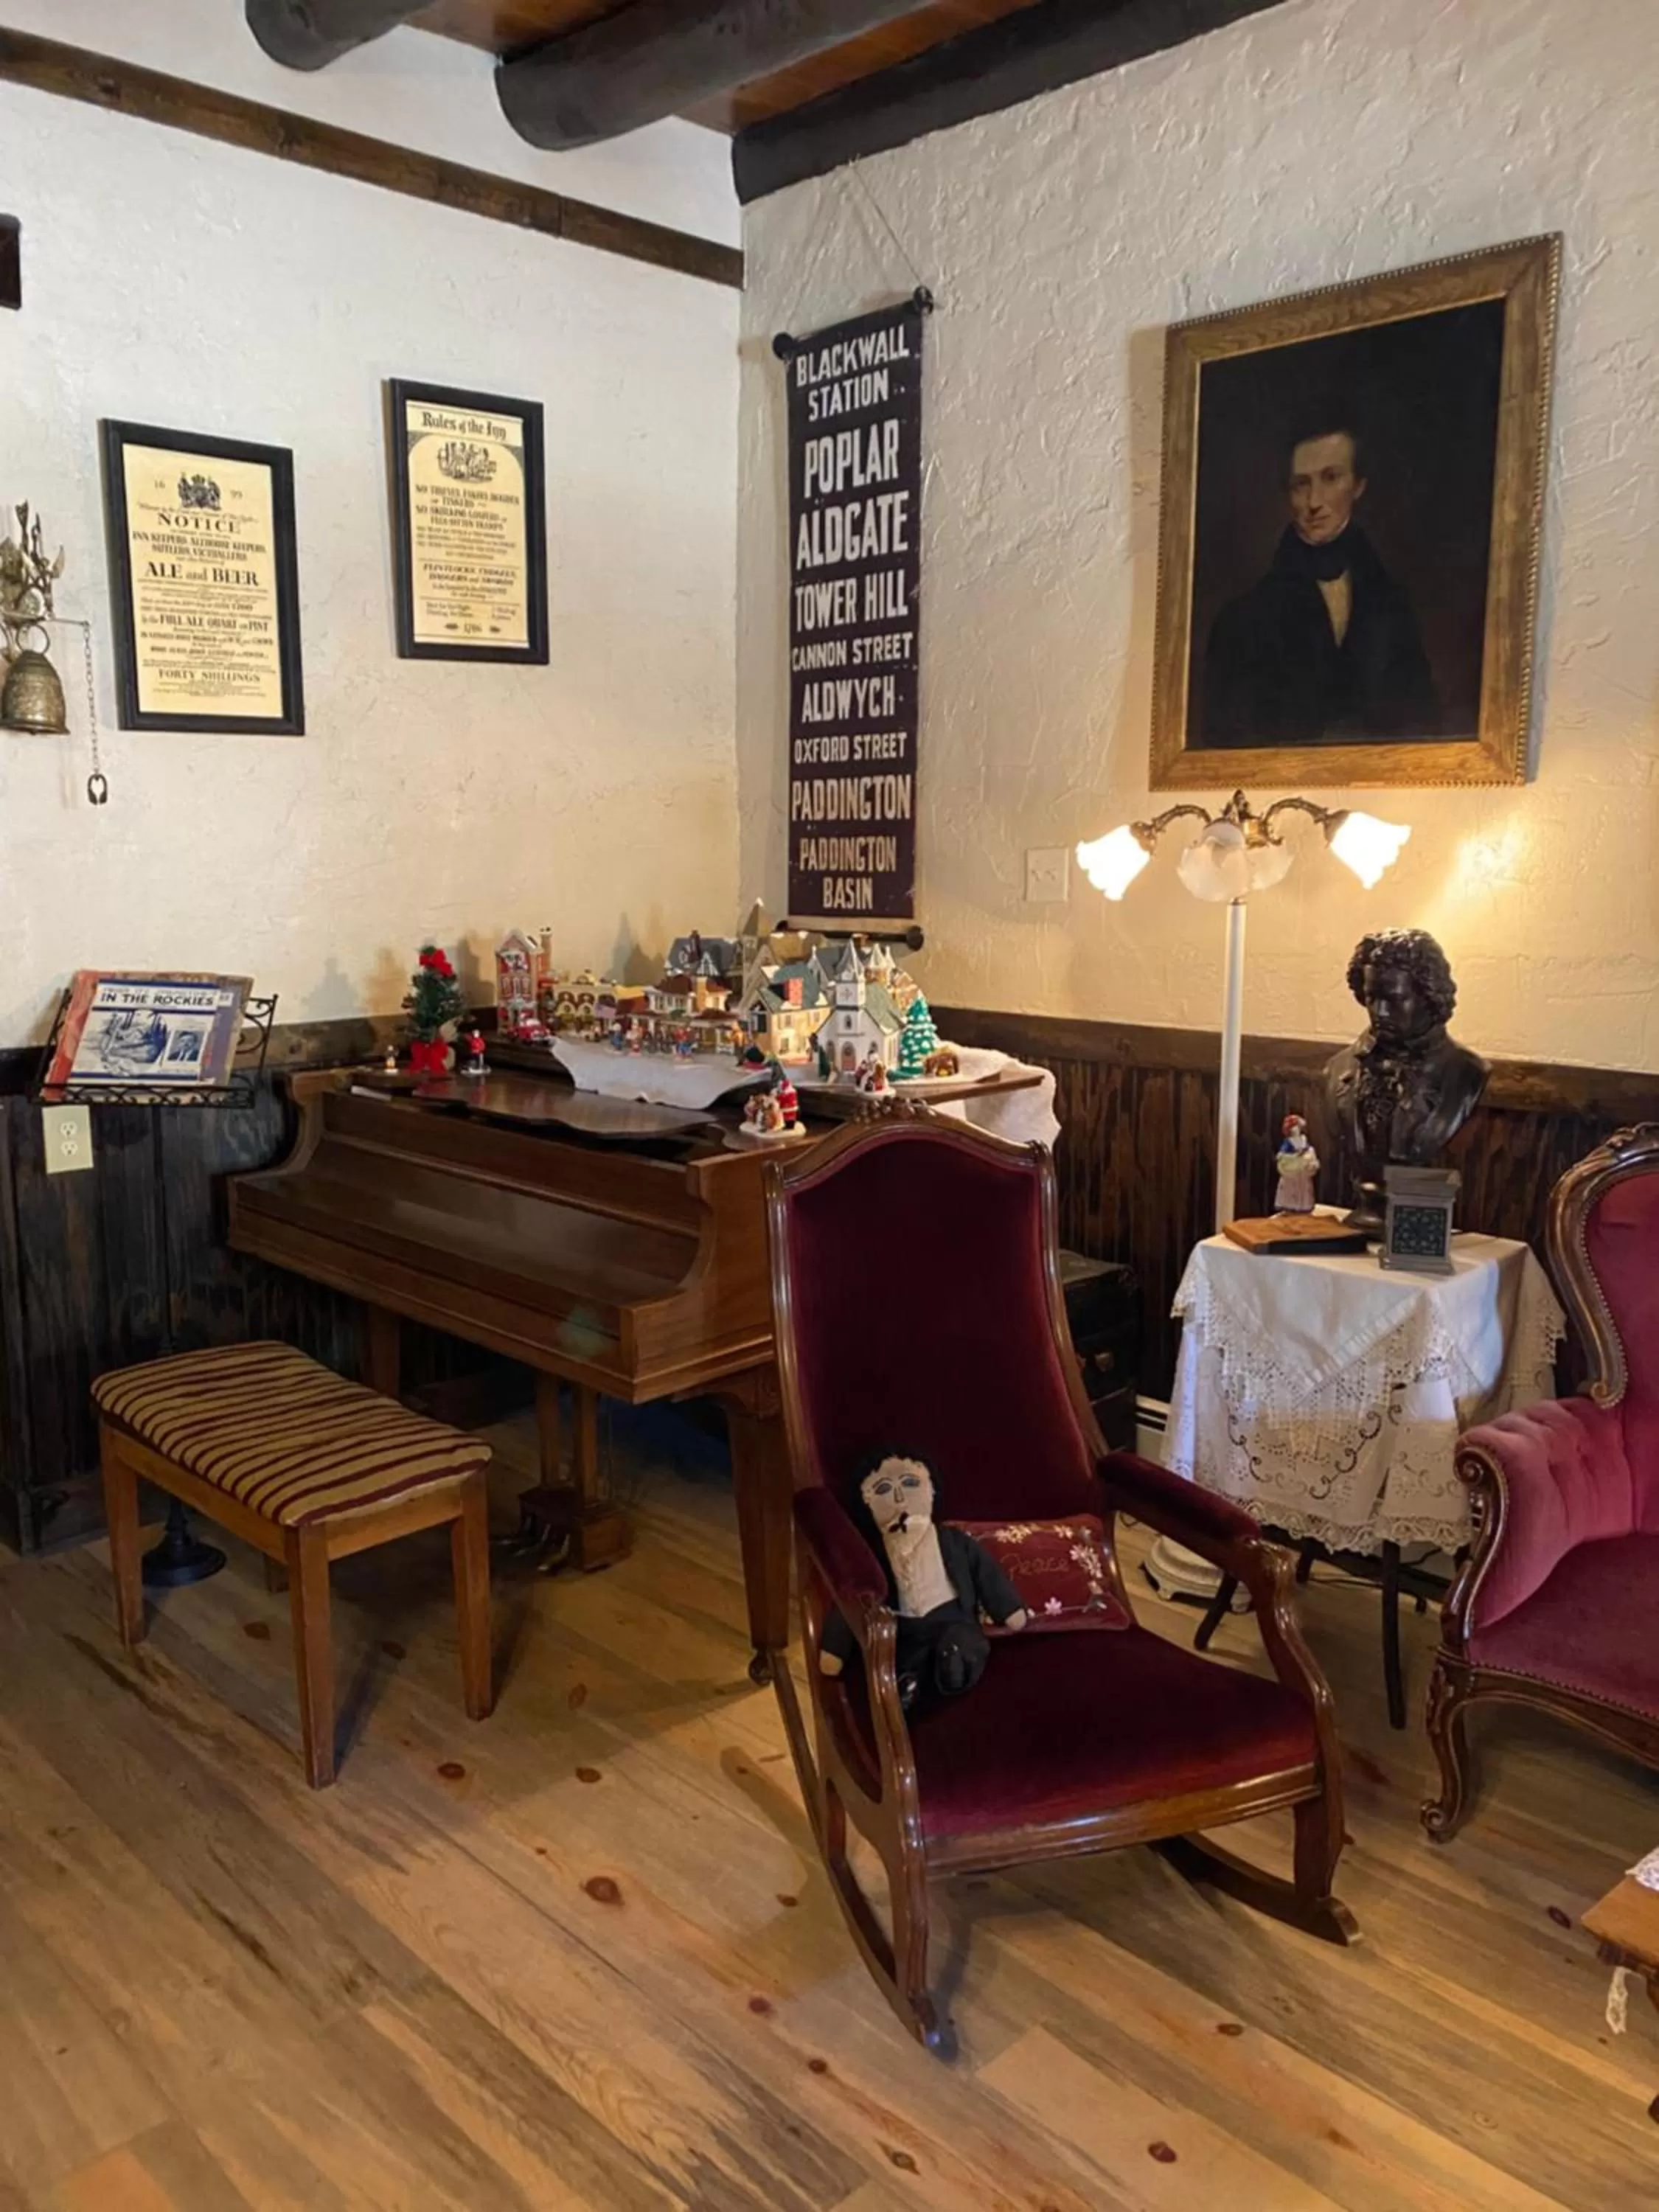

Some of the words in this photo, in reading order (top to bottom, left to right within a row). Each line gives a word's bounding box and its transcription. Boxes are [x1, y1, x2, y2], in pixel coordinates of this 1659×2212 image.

[796, 324, 910, 387] BLACKWALL
[808, 368, 888, 422] STATION
[422, 411, 456, 431] Rules
[468, 418, 484, 434] the
[804, 418, 900, 499] POPLAR
[158, 512, 240, 534] NOTICE
[796, 490, 910, 571] ALDGATE
[145, 561, 183, 579] ALE
[186, 568, 208, 580] and
[212, 567, 260, 586] BEER
[795, 578, 857, 632] TOWER
[865, 569, 908, 622] HILL
[792, 640, 847, 672] CANNON
[852, 632, 914, 665] STREET
[159, 669, 195, 679] FORTY
[201, 671, 260, 682] SHILLINGS
[801, 675, 895, 723] ALDWYCH
[794, 735, 849, 765] OXFORD
[853, 732, 908, 761] STREET
[792, 774, 911, 821] PADDINGTON
[799, 835, 897, 872] PADDINGTON
[822, 877, 874, 911] BASIN
[100, 993, 117, 1003] IN
[122, 994, 149, 1004] THE
[153, 995, 213, 1006] ROCKIES
